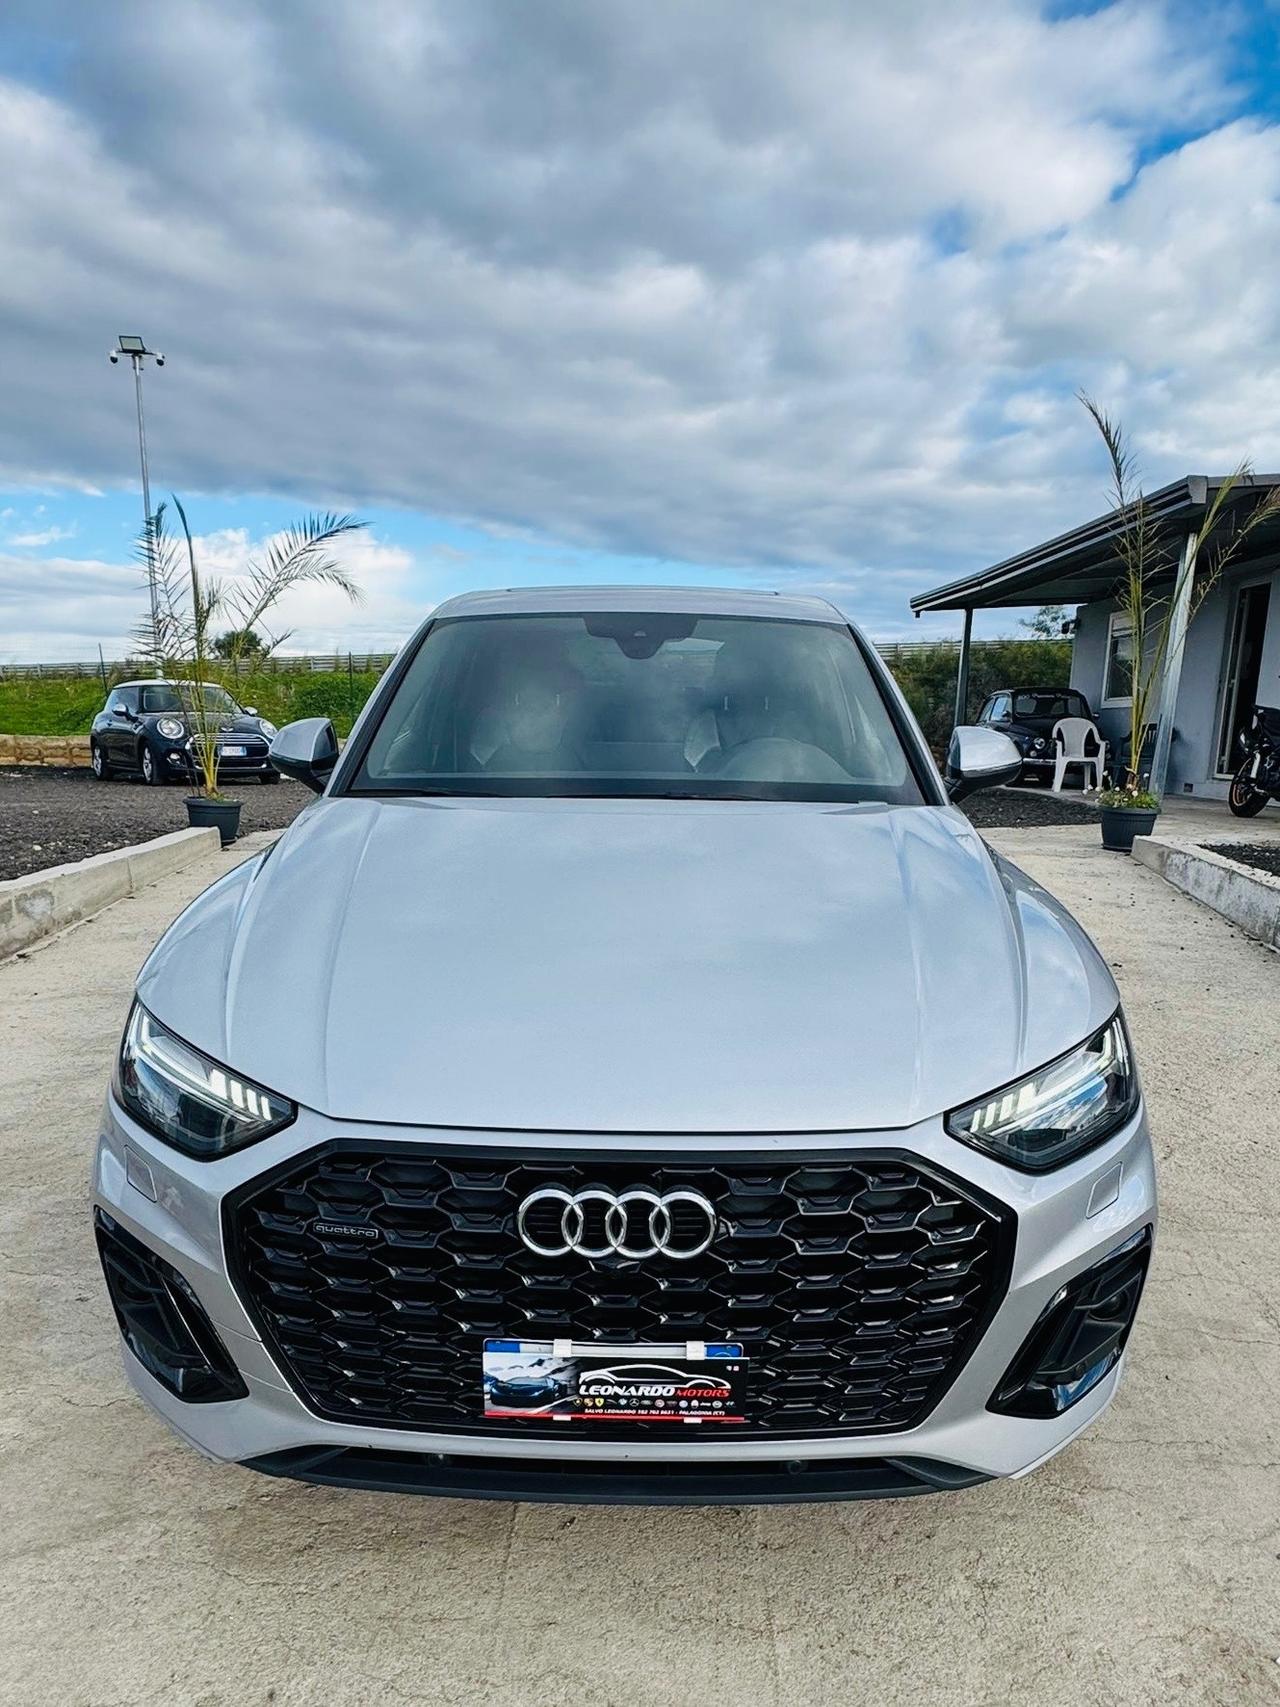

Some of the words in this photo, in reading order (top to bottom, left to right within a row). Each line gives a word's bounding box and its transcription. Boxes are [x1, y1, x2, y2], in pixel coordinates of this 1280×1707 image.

[316, 1225, 375, 1237] quattro
[579, 1385, 676, 1397] LEONARDO
[676, 1389, 731, 1397] MOTORS
